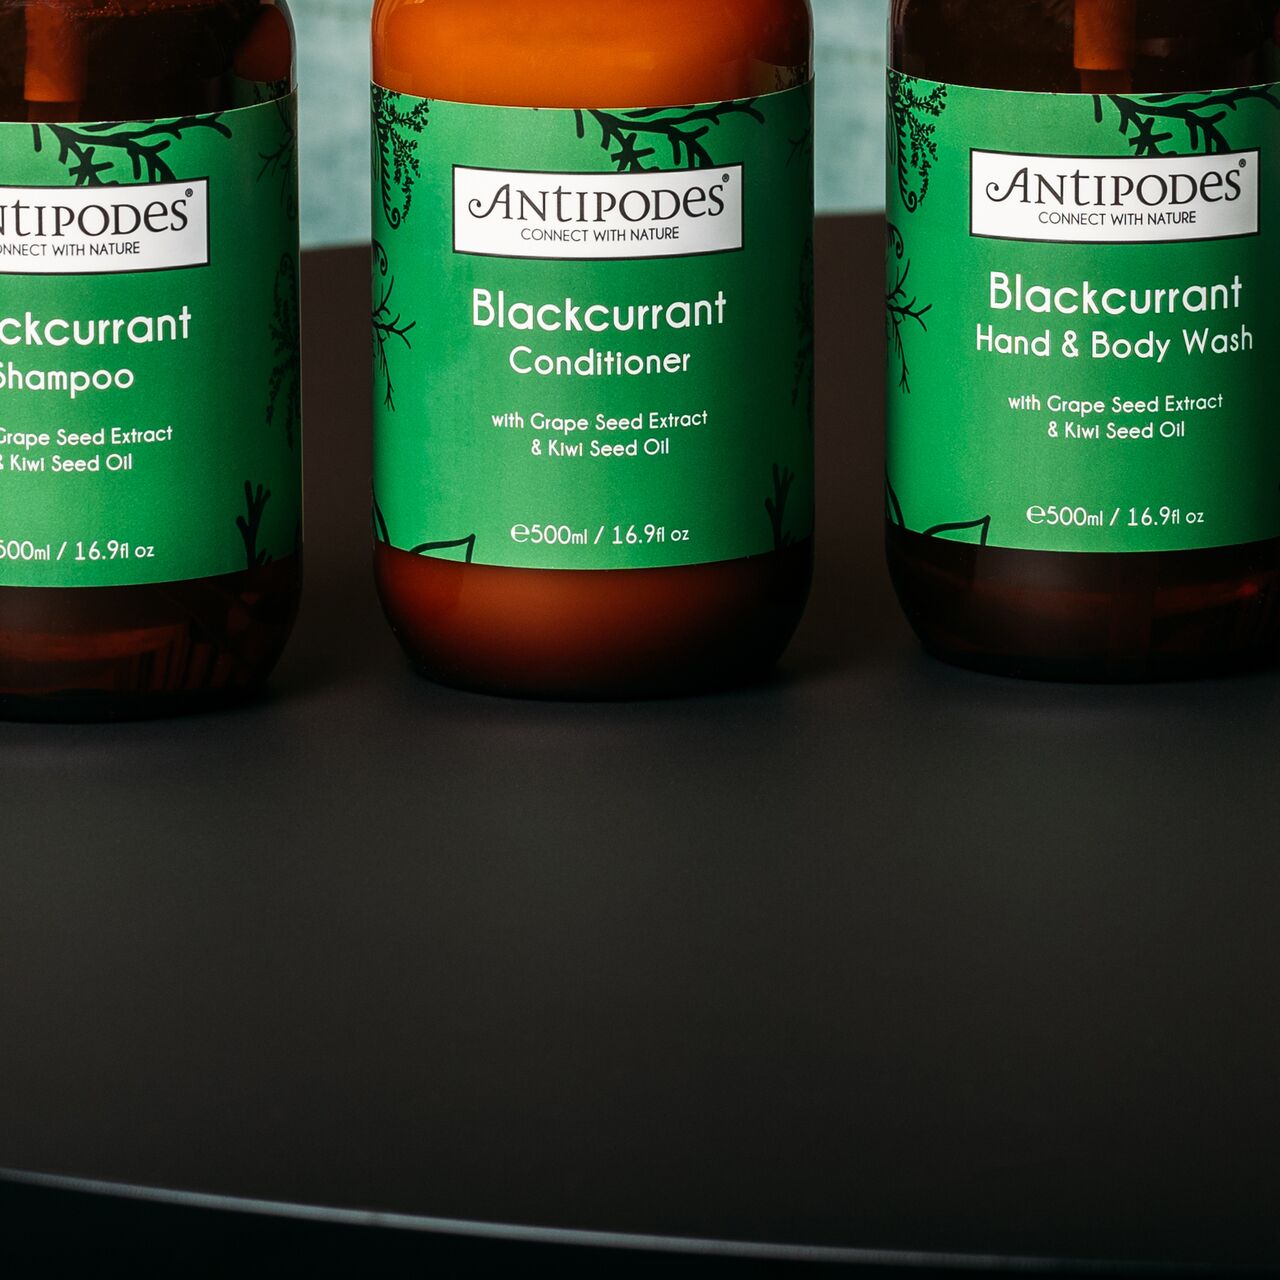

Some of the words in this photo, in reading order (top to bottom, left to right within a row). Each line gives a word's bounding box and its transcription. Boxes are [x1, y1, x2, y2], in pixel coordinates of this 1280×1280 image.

[1038, 211, 1107, 226] CONNECT
[1110, 212, 1144, 226] WITH
[1147, 210, 1197, 226] NATURE
[520, 227, 589, 242] CONNECT
[593, 228, 626, 242] WITH
[630, 225, 680, 241] NATURE
[51, 243, 86, 257] WITH
[89, 240, 141, 256] NATURE
[989, 271, 1242, 315] Blackcurrant
[472, 287, 727, 332] Blackcurrant
[976, 323, 1050, 357] Hand
[1061, 329, 1079, 358] &
[1091, 330, 1171, 363] Body
[1182, 324, 1253, 355] Wash
[508, 345, 691, 376] Conditioner
[1007, 393, 1041, 411] with
[1046, 394, 1106, 418] Grape
[1111, 395, 1159, 414] Seed
[1165, 393, 1223, 412] Extract
[491, 411, 525, 429] with
[530, 412, 589, 436] Grape
[595, 413, 643, 431] Seed
[649, 410, 708, 429] Extract
[1047, 420, 1059, 438] &
[1064, 421, 1100, 439] Kiwi
[1105, 421, 1154, 440] Seed
[1159, 420, 1185, 438] Oil
[56, 428, 105, 446] Seed
[111, 425, 173, 445] Extract
[531, 438, 542, 456] &
[548, 439, 583, 457] Kiwi
[589, 439, 638, 457] Seed
[643, 437, 669, 456] Oil
[10, 454, 45, 472] Kiwi
[51, 454, 100, 473] Seed
[105, 452, 133, 471] Oil
[1185, 511, 1205, 524] oz
[670, 529, 690, 542] oz
[134, 545, 155, 558] oz
